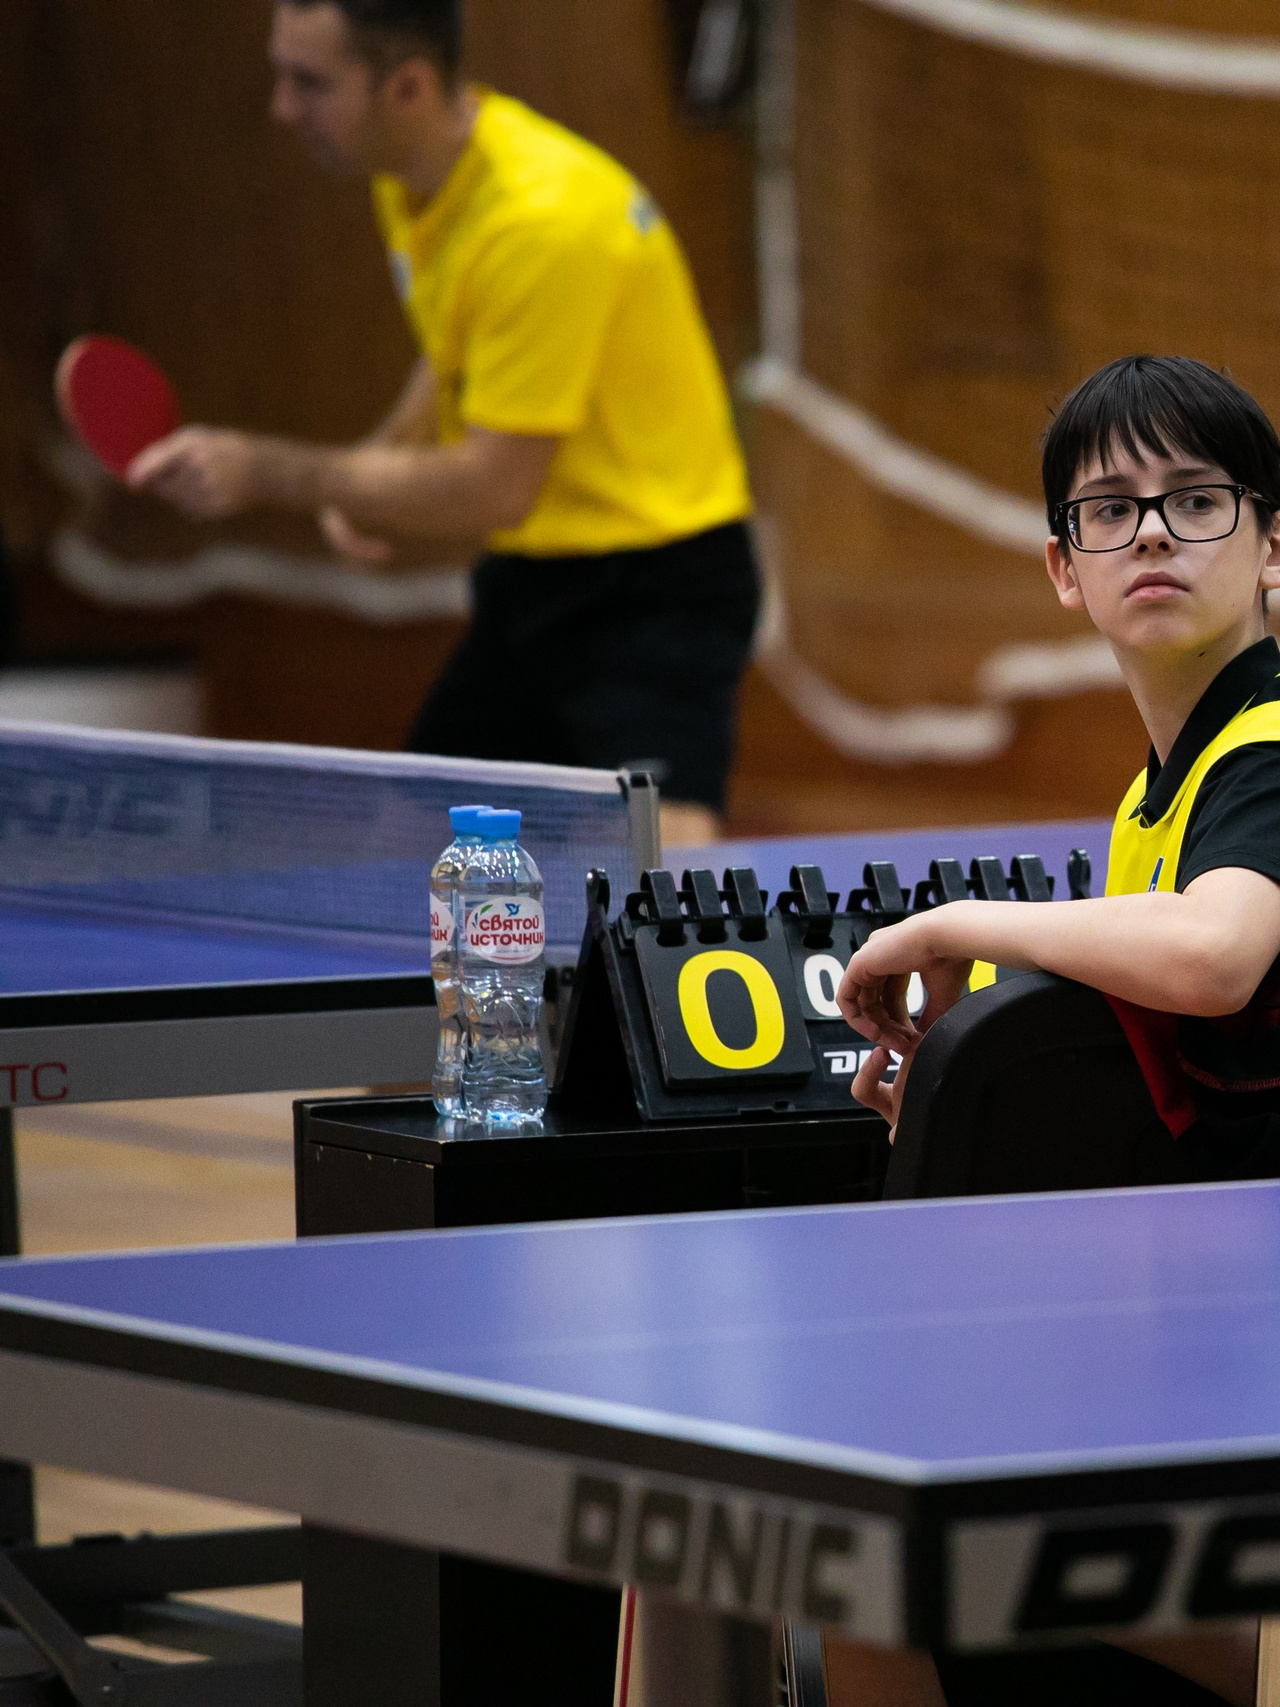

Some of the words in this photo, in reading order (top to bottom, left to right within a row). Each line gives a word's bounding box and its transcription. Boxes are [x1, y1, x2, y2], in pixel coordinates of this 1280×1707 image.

[678, 950, 785, 1070] 0
[0, 1062, 68, 1102] TC
[565, 1473, 856, 1624] DONIC
